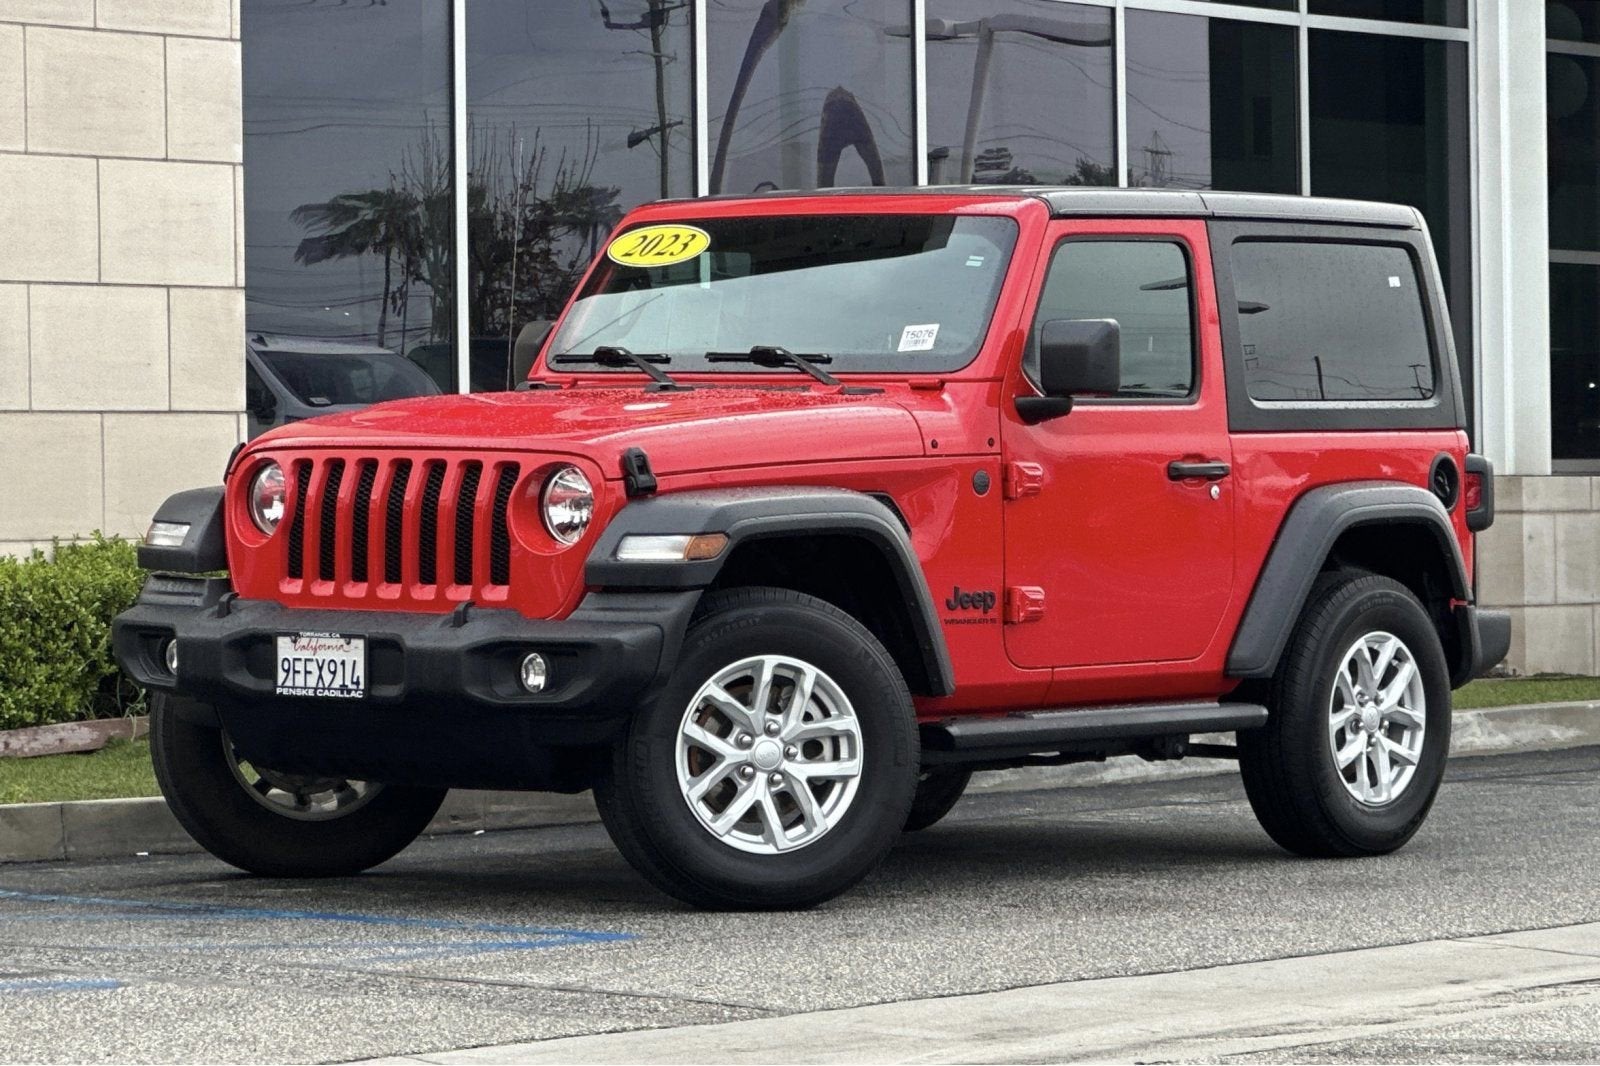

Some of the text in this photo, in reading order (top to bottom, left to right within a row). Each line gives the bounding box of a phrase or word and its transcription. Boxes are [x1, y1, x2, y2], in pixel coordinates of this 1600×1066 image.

[621, 233, 697, 257] 2023
[945, 586, 996, 615] Jeep
[294, 638, 351, 656] California
[281, 657, 361, 689] 9FFX914
[276, 687, 363, 698] PENSKE CADILLAC
